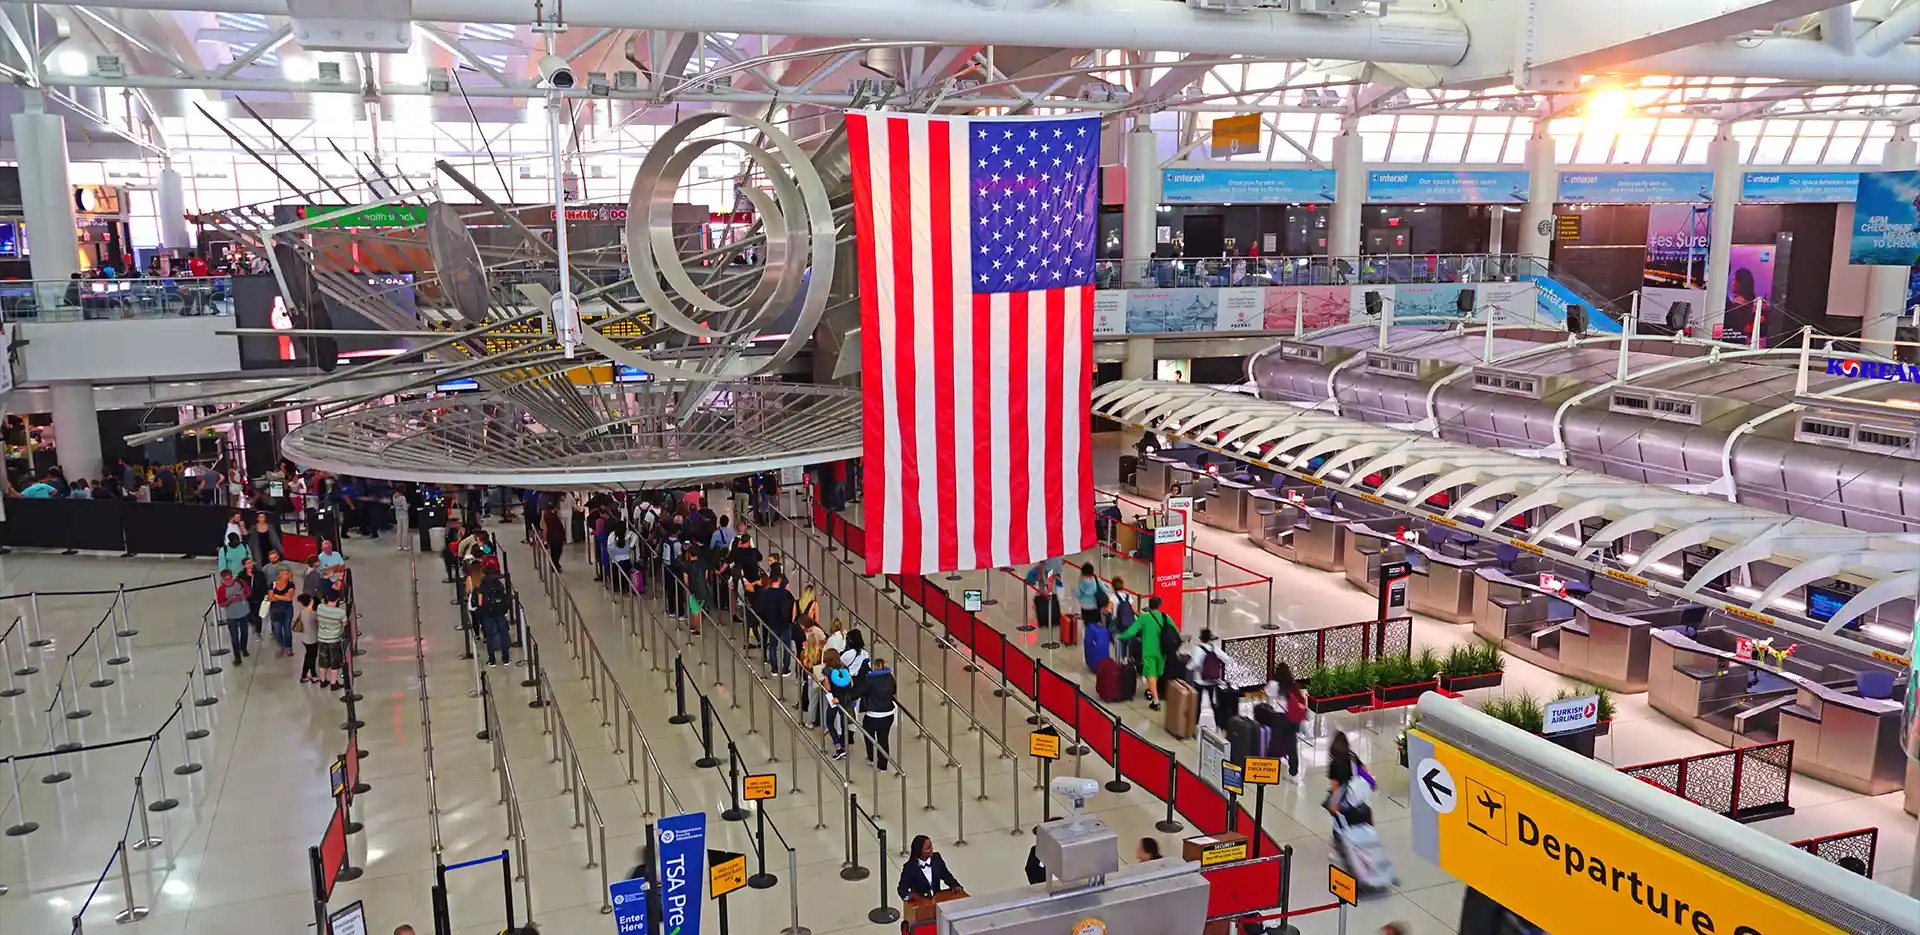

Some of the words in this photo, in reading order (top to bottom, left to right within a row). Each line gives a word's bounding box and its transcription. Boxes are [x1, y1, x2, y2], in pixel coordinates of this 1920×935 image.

[551, 209, 598, 220] DNKIN'
[1825, 357, 1920, 385] KOREAN
[1157, 573, 1181, 582] ECONOMY
[1161, 580, 1177, 588] CLASS
[1552, 706, 1584, 717] TURKISH
[1551, 713, 1583, 724] AIRLINES
[666, 853, 686, 893] TSA
[1517, 811, 1715, 935] Departure
[669, 894, 687, 927] Pre
[619, 914, 644, 925] Enter
[621, 923, 643, 932] Here
